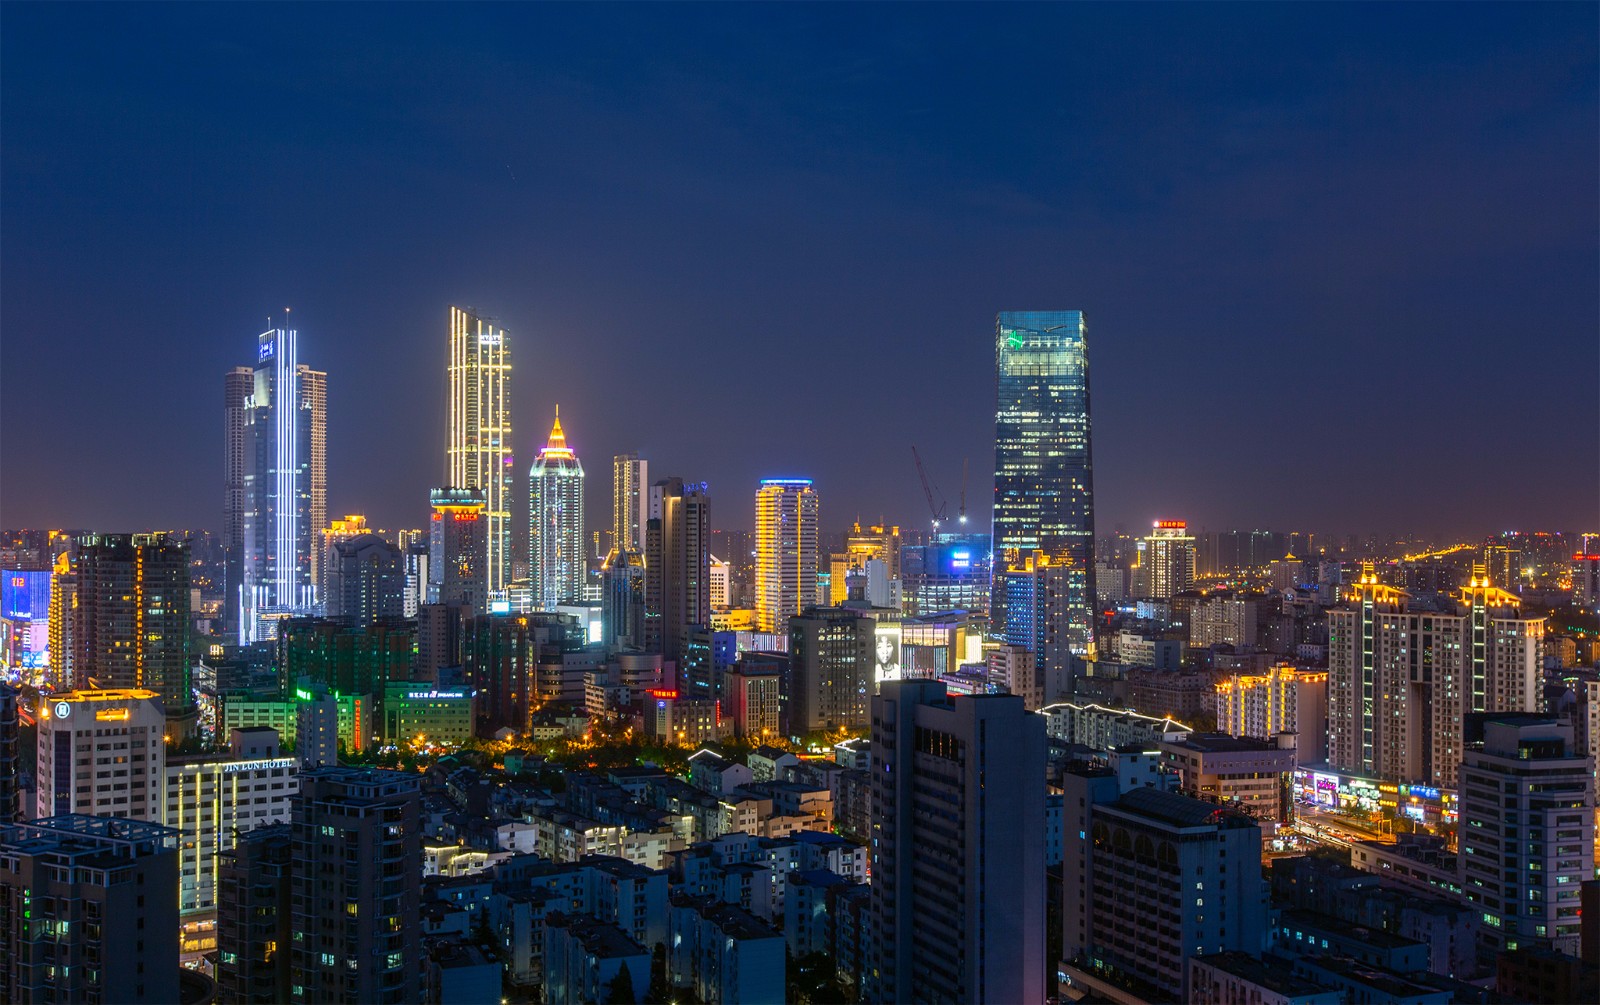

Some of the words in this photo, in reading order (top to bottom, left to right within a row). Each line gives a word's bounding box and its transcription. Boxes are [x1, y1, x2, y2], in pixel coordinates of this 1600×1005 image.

[224, 764, 239, 772] JIN
[241, 762, 260, 770] LUN
[262, 759, 292, 769] HOTEL
